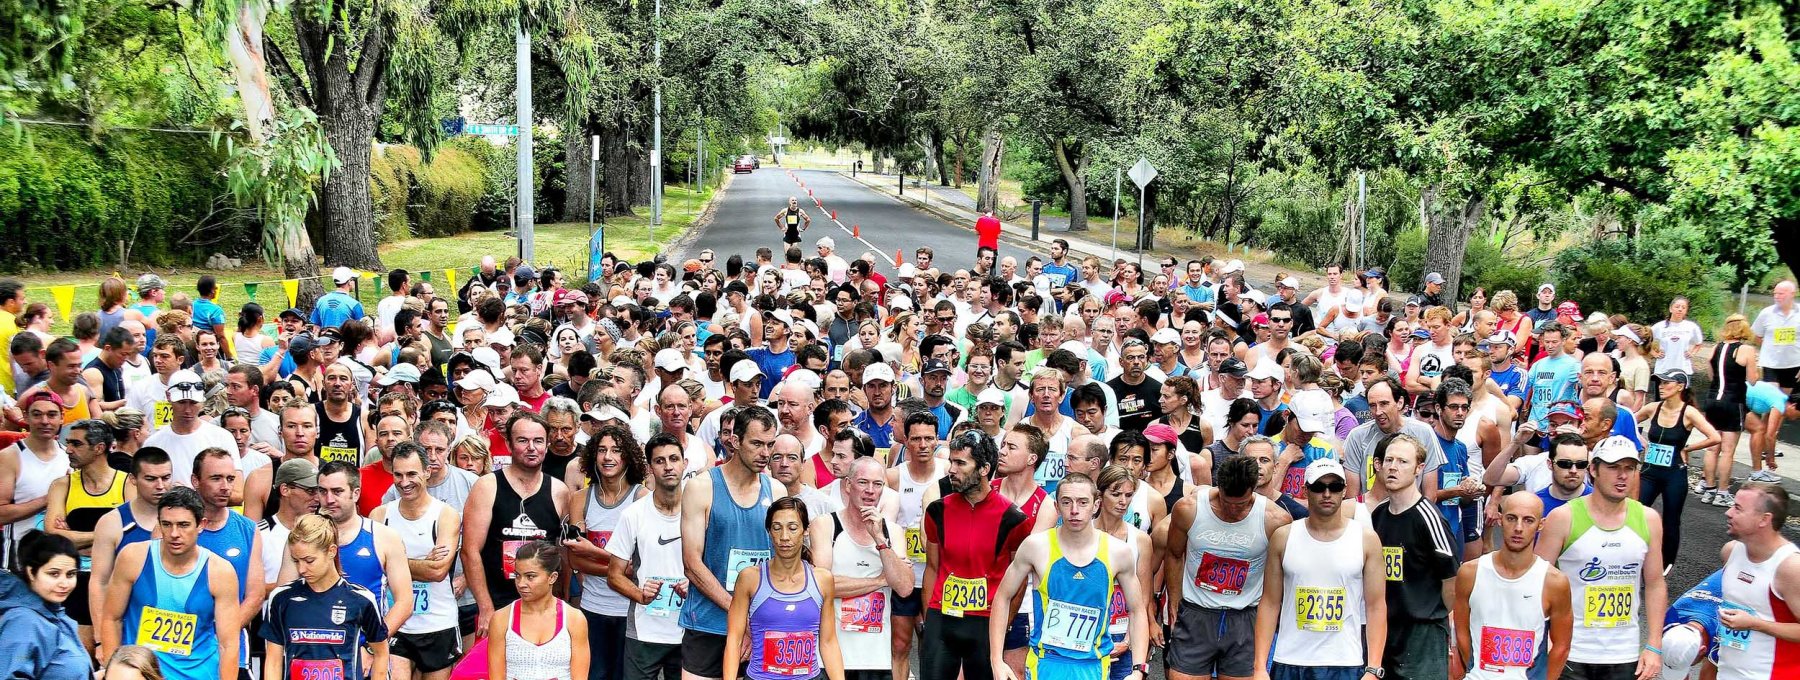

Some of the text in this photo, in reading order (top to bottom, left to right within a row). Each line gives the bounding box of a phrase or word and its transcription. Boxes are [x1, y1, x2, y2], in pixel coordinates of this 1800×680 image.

[1539, 388, 1552, 401] 816
[1043, 459, 1064, 478] 738
[1655, 449, 1672, 465] 775
[1209, 561, 1246, 588] 3516
[1385, 555, 1402, 578] 85
[944, 584, 986, 608] B 2349
[1298, 594, 1344, 621] B 2355
[1588, 592, 1633, 618] B 2389
[854, 600, 885, 625] 3358
[1060, 603, 1081, 611] CHINMOY
[1081, 607, 1096, 615] RACES
[151, 616, 194, 645] 2292
[300, 631, 344, 641] Nationwide
[1047, 609, 1061, 629] B
[1066, 612, 1098, 641] 777
[775, 639, 813, 665] 3509
[1491, 635, 1534, 664] 3388
